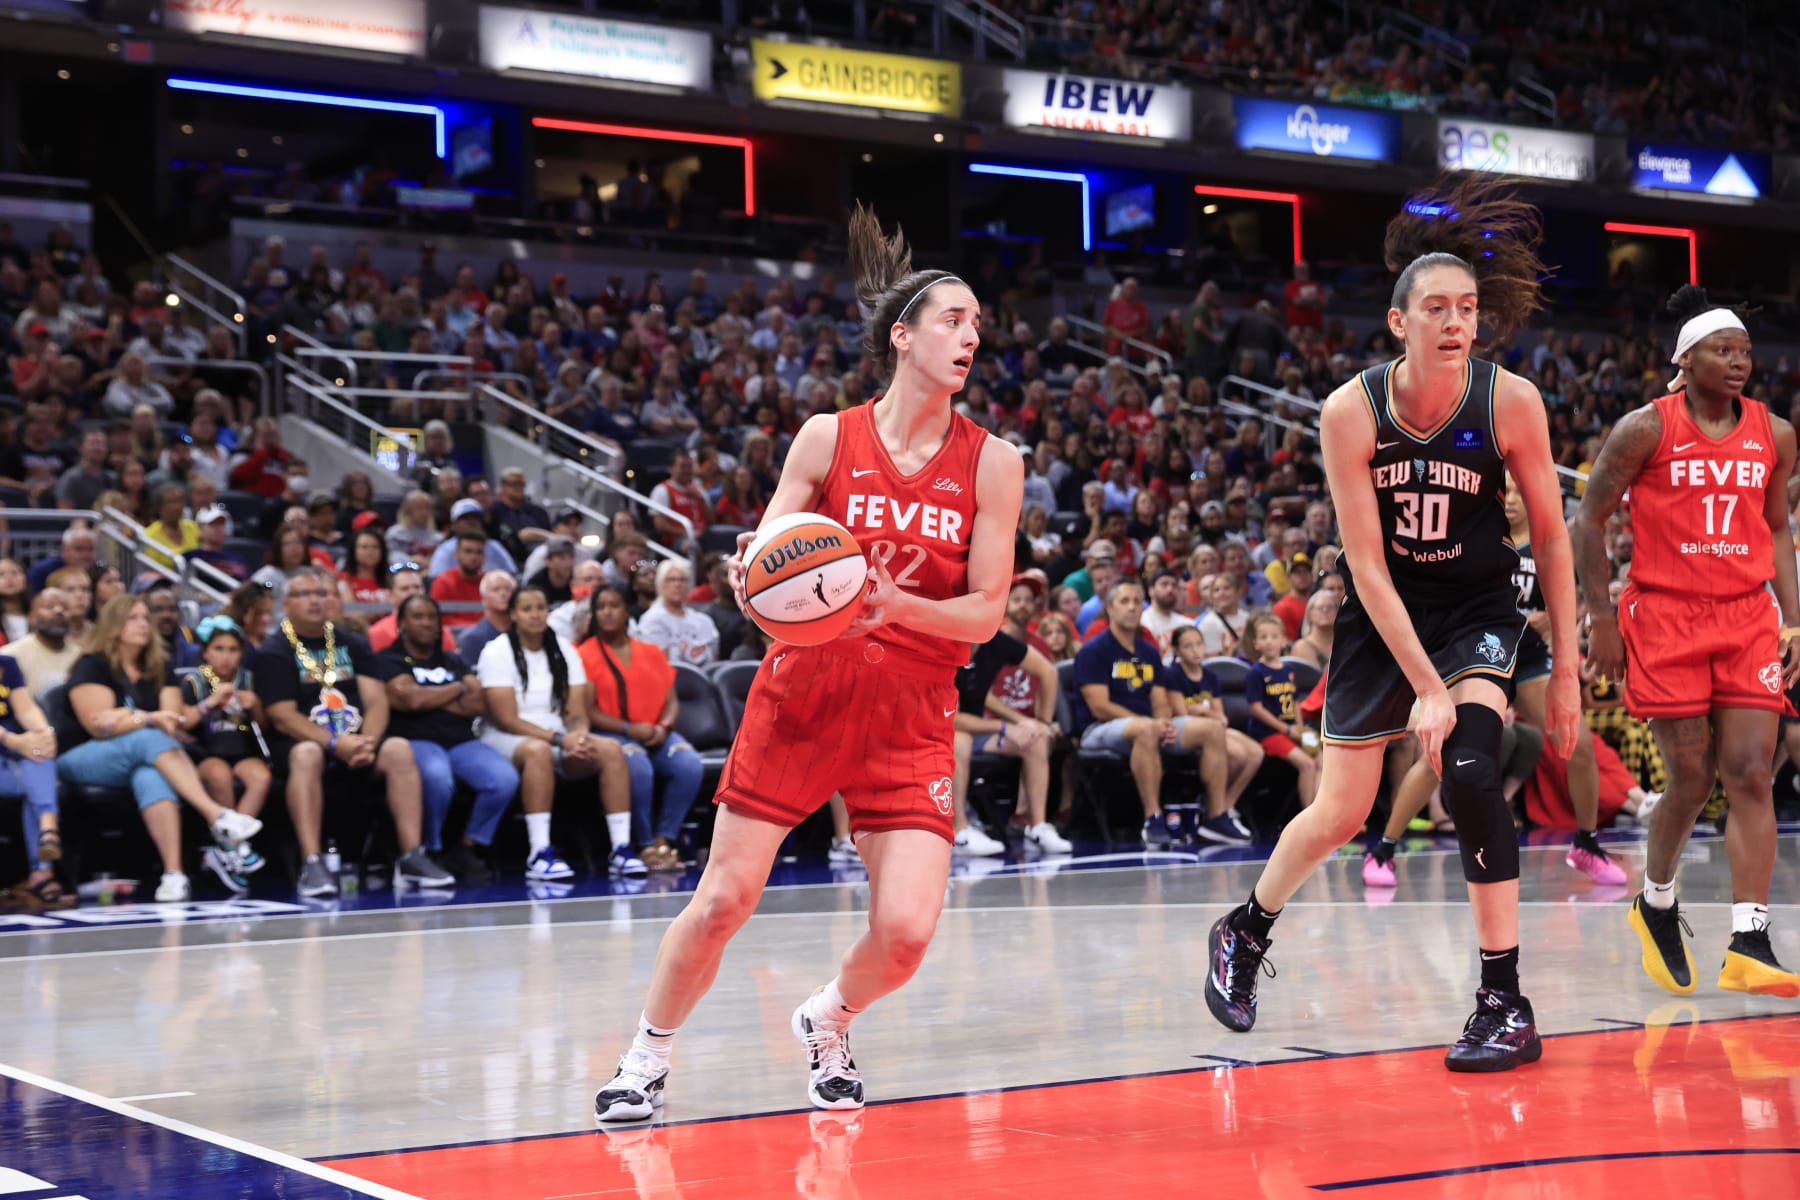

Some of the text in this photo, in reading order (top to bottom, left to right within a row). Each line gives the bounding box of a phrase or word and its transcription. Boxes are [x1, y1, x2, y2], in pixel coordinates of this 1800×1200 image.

[798, 57, 950, 105] GAINBRIDGE
[1044, 77, 1155, 117] IBEW
[1286, 104, 1351, 156] Kroger
[1439, 126, 1595, 181] aes Indiana
[932, 477, 964, 497] Lilly
[1373, 460, 1482, 496] EW YORK
[1670, 459, 1766, 489] FEVER
[846, 494, 963, 545] FEVER
[1393, 491, 1450, 541] 30
[1701, 493, 1739, 536] 17
[759, 532, 843, 575] Wilson
[1412, 543, 1462, 563] Webull
[1680, 540, 1749, 557] salesforce
